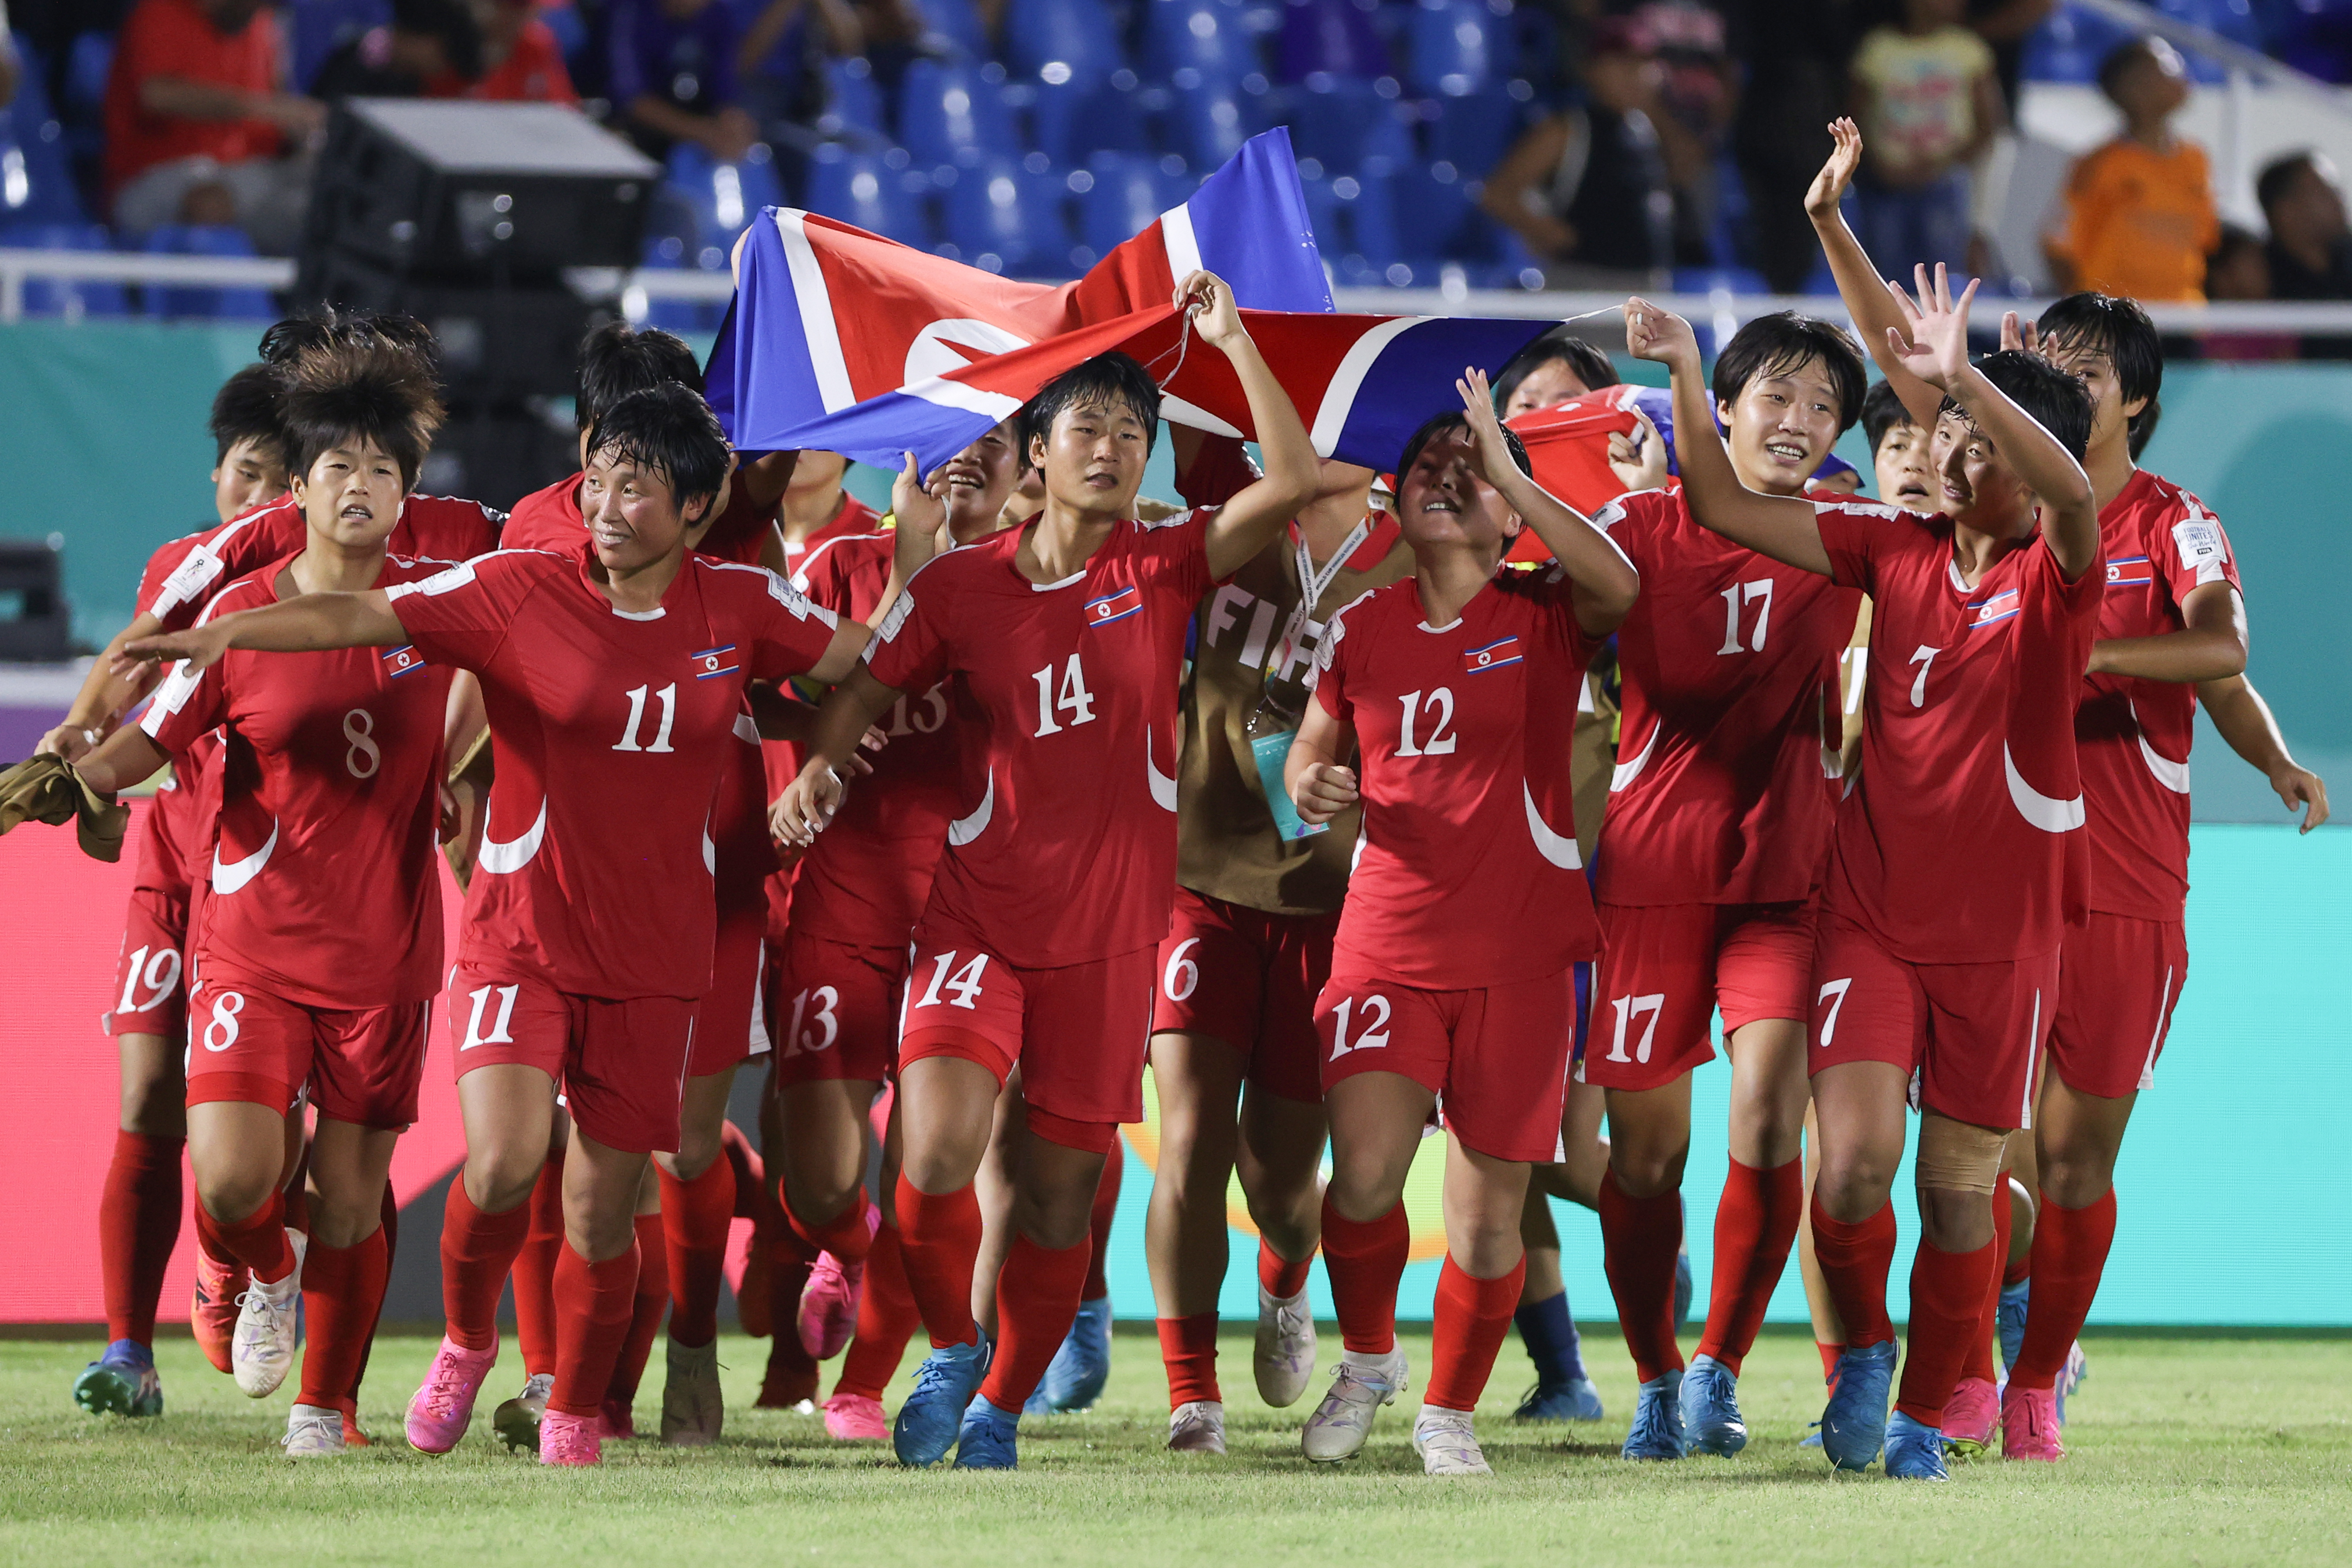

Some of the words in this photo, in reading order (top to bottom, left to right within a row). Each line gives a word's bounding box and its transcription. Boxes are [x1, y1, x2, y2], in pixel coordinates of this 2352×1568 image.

[2186, 532, 2213, 541] UNITES
[1717, 578, 1773, 656] 17
[1032, 653, 1096, 738] 14
[1909, 645, 1942, 707] 7
[343, 708, 381, 779] 8
[612, 682, 675, 753] 11
[1394, 687, 1456, 756] 12
[116, 945, 182, 1014] 19
[915, 950, 989, 1009] 14
[1164, 937, 1201, 1001] 6
[203, 991, 245, 1052] 8
[460, 984, 519, 1051] 11
[785, 986, 839, 1057] 13
[1329, 994, 1391, 1062] 12
[1606, 994, 1664, 1064] 17
[1817, 978, 1852, 1047] 7
